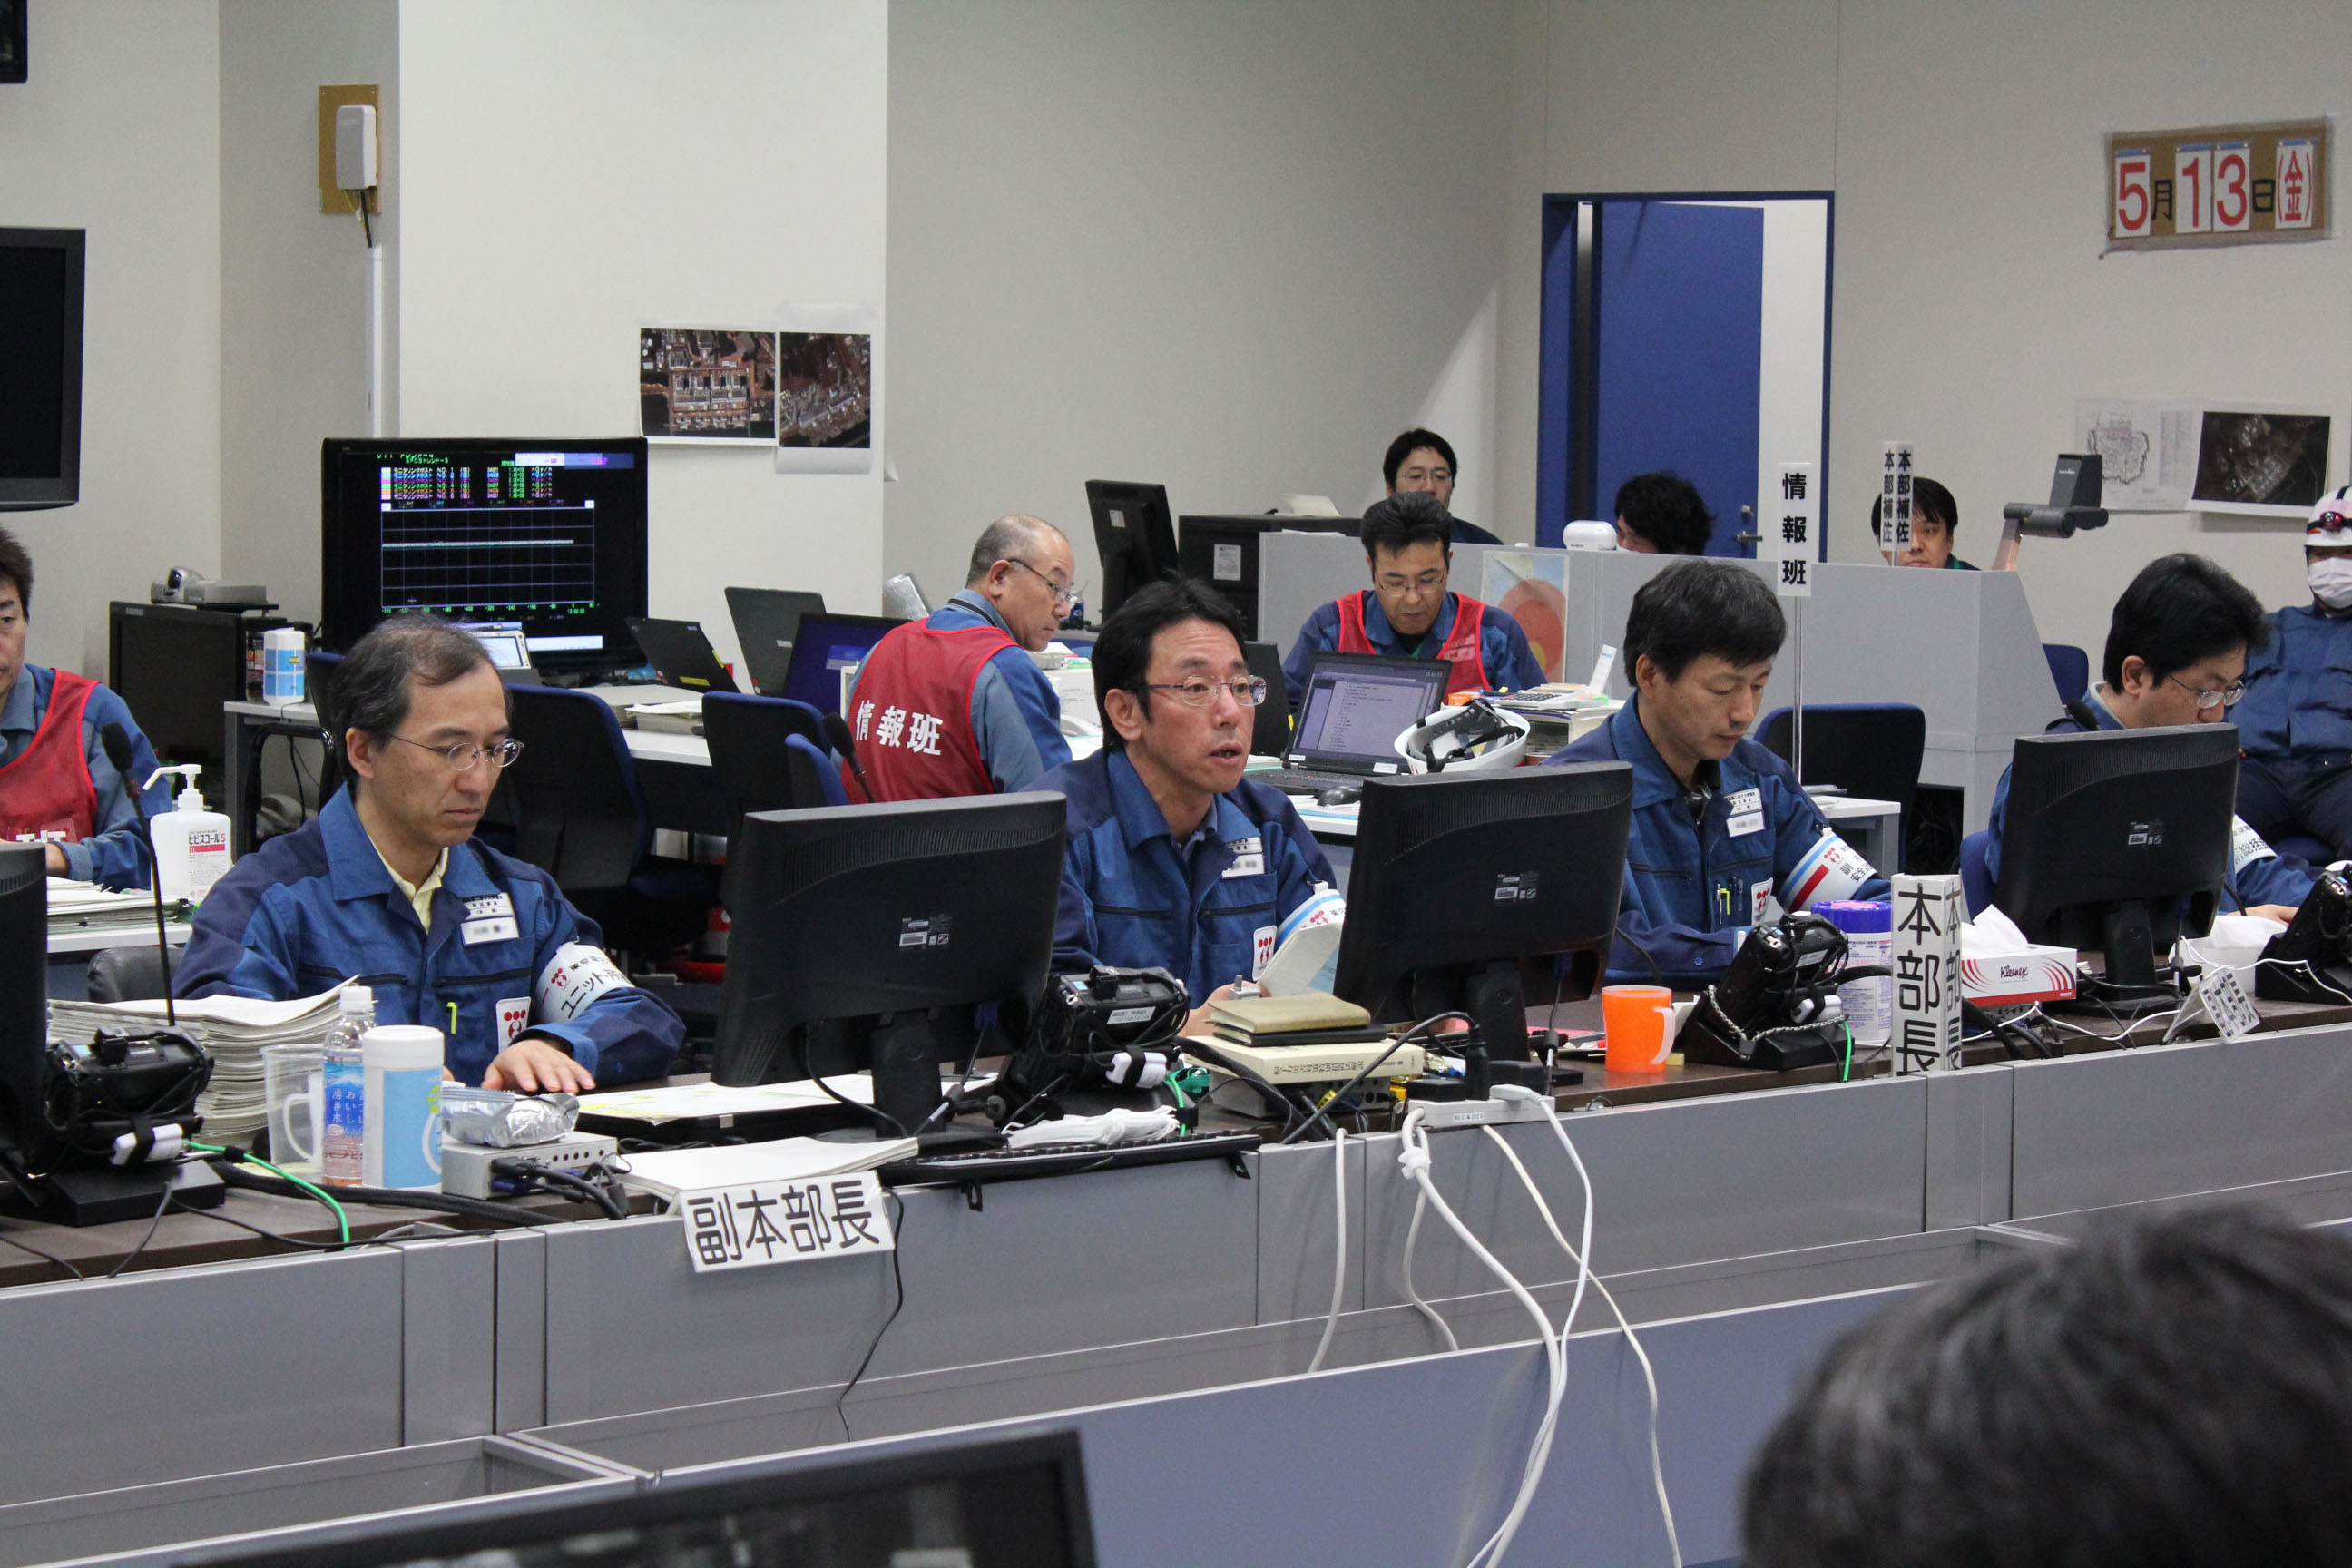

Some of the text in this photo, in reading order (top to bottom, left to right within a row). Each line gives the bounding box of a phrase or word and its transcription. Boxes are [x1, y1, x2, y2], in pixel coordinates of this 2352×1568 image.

[1782, 473, 1807, 585] 情報班
[1883, 449, 1895, 543] 本部補佐
[1896, 449, 1912, 543] 本部補佐
[856, 699, 944, 756] 情報班
[189, 833, 225, 845] ヒビスコールS
[1896, 883, 1942, 1076] 本部長
[2000, 965, 2028, 979] Kleenex
[345, 1091, 356, 1134] おいしい
[687, 1180, 880, 1266] 副本部長
